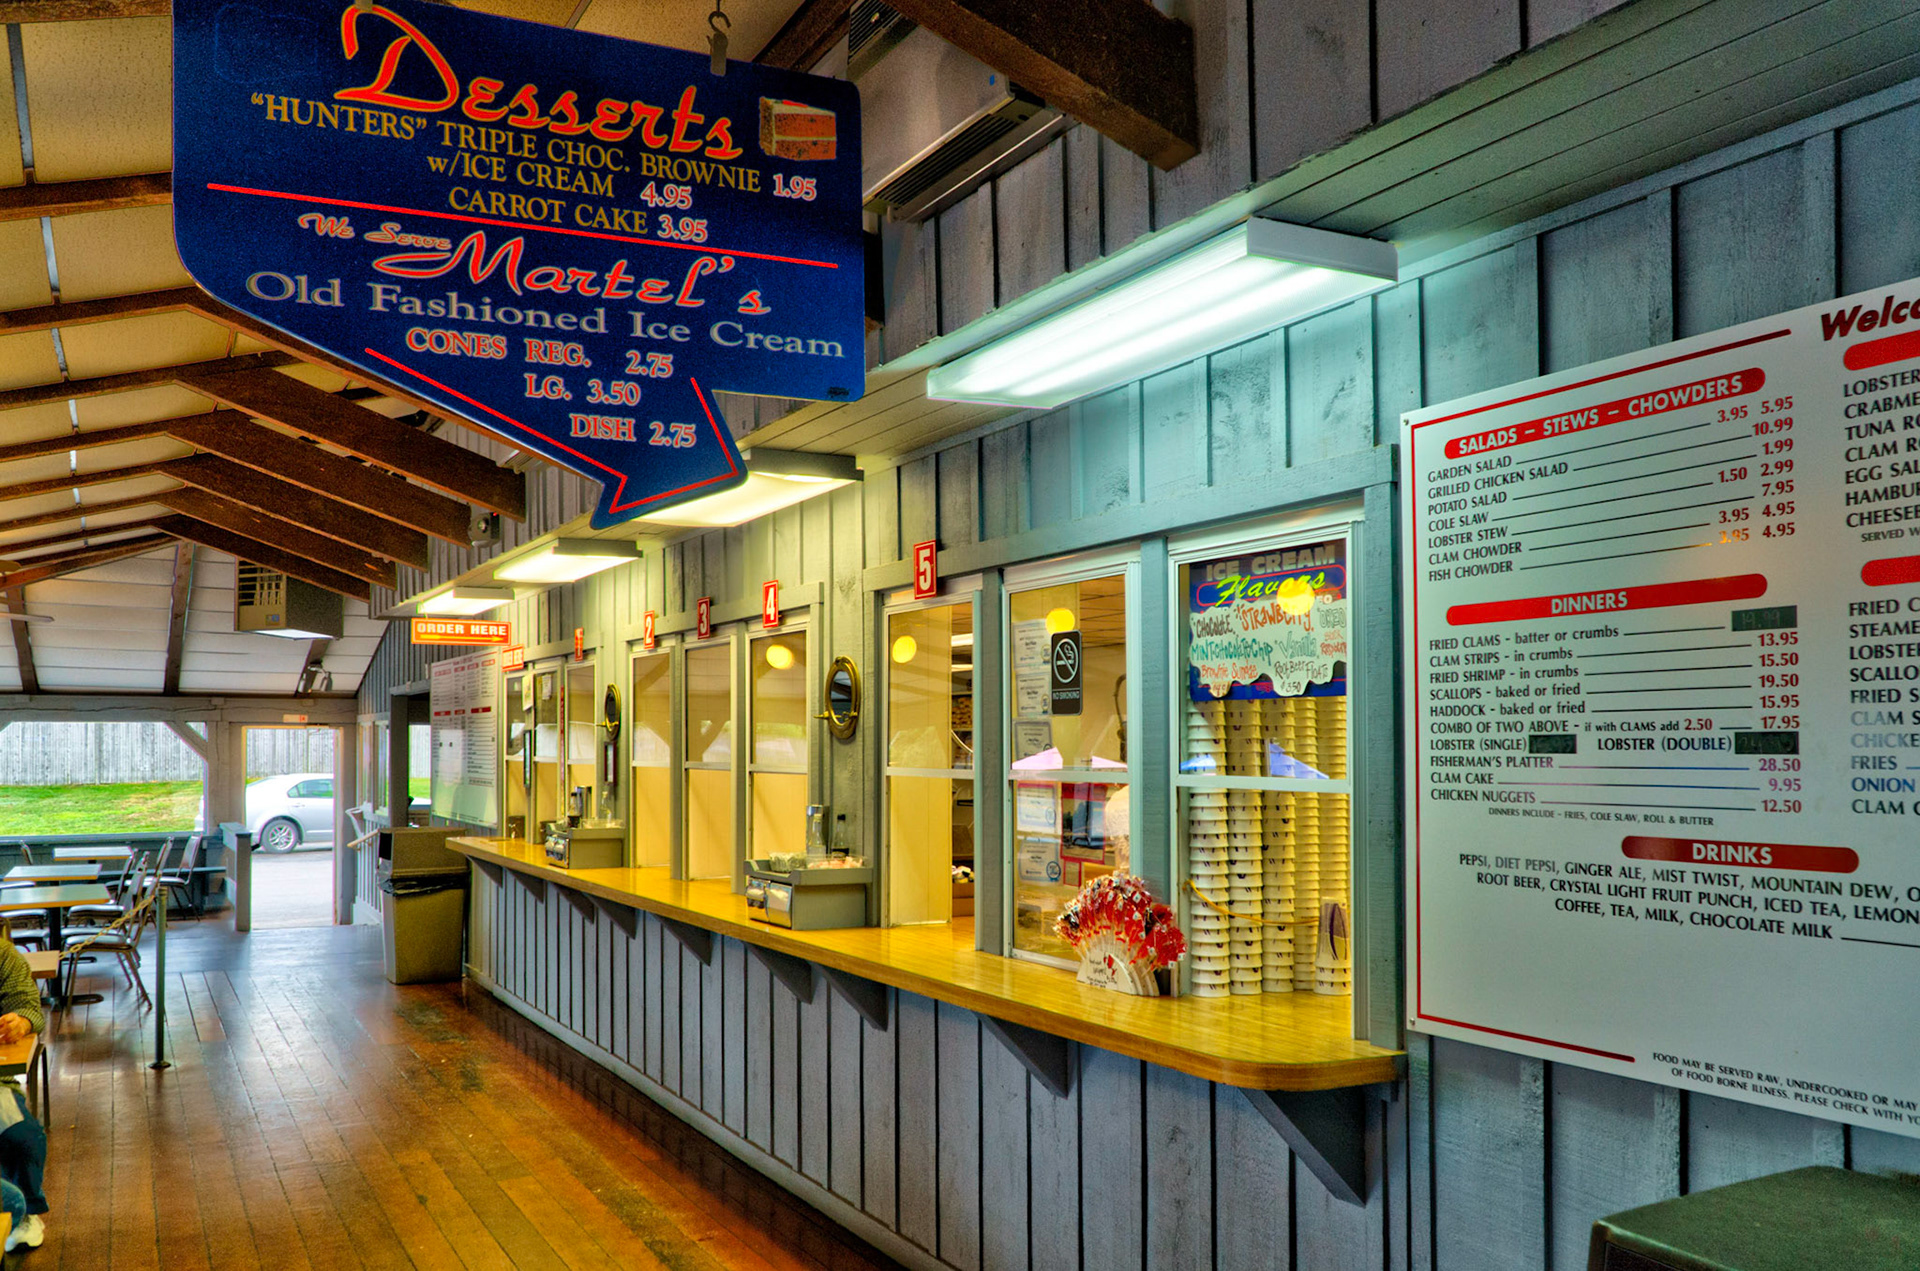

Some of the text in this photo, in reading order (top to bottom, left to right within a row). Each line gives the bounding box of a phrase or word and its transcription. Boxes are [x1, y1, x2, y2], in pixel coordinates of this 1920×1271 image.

[334, 4, 743, 160] Desserts
[436, 120, 538, 159] TRIPLE
[547, 139, 631, 172] CHOC.
[640, 152, 761, 193] BROWNIE
[773, 173, 817, 201] 1.95
[427, 150, 693, 209] w/ICE CREAM 4.95
[450, 186, 708, 242] CARROT CAKE 3.95
[297, 212, 452, 250] We Serve
[372, 230, 771, 315] Martel's
[246, 271, 845, 358] Old Fashioned Ice Cream
[406, 328, 673, 377] CONES REG. 2.75
[524, 373, 641, 405] LG. 3.50
[570, 414, 697, 448] DISH 2.75
[1459, 375, 1743, 454] SALADS STEWS CHOWDERS
[1845, 419, 1895, 441] TUNA
[1428, 396, 1793, 483] GARDEN SALAD 3.95 5.95
[1845, 441, 1898, 463] CLAM
[1428, 417, 1793, 500] GRILLED CHICKEN SALAD 10.99
[1845, 465, 1882, 485] EGG
[1428, 438, 1793, 516] POTATO SALAD 1.99
[1428, 459, 1794, 532] COLE SLAW 1.50 2.99
[1428, 480, 1794, 549] LOBSTER STEW 7.95
[1429, 502, 1795, 565] CLAM CHOWDER 3.95 4.95
[1861, 528, 1904, 543] SERVED
[1207, 545, 1336, 581] ICE CREAM
[1429, 522, 1795, 582] FISH CHOWDER 3.95 4.95
[918, 548, 932, 591] 5
[1215, 572, 1326, 607] Flavors
[1551, 590, 1628, 615] DINNERS
[700, 603, 708, 635] 3
[765, 594, 775, 621] 4
[1849, 599, 1900, 616] FRIED
[417, 623, 507, 636] ORDER HERE
[645, 615, 653, 643] 2
[1429, 625, 1620, 651] FRIED CLAMS batter crumbs
[1430, 632, 1799, 668] CLAM STRIPS crumbs 13.95
[1430, 653, 1799, 684] FRIED SHRIMP crumbs 15.50
[1430, 674, 1799, 701] SCALLOPS baked fried 19.50
[1850, 688, 1901, 703] FRIED
[1430, 695, 1800, 717] HADDOCK baked fried 15.95
[1851, 710, 1904, 726] CLAM
[1430, 716, 1800, 734] COMBO OF TWO ABOVE CLAMS add 2.50 17.95
[1430, 738, 1475, 751] LOBSTER
[1480, 737, 1527, 751] (SINGLE)
[1598, 738, 1655, 751] LOBSTER
[1661, 736, 1732, 752] (DOUBLE)
[1430, 756, 1801, 772] FISHERMAN'S PLATTER 28.50
[1851, 755, 1897, 770] FRIES
[1431, 773, 1801, 792] CLAM CAKE 9.95
[1851, 777, 1915, 793] ONION
[1431, 789, 1802, 813] CHICKEN NUGGETS 12.50
[1852, 799, 1905, 815] CLAM
[1692, 842, 1772, 865] DRINKS
[1459, 854, 1899, 903] PEPSI, DIET PEPSI, GINGER ALE, MIST TWIST, MOUNTAIN DEW,
[1477, 872, 1847, 921] ROOT BEER, CRYSTAL LIGHT FRUIT PUNCH, ICED TEA,
[1555, 898, 1833, 939] COFFEE, TEA, MILK, CHOCOLATE MILK
[1687, 1071, 1869, 1116] FOOD BORNE PLEASE CHECK
[1719, 1065, 1868, 1101] SERVED UNDERCOOKED
